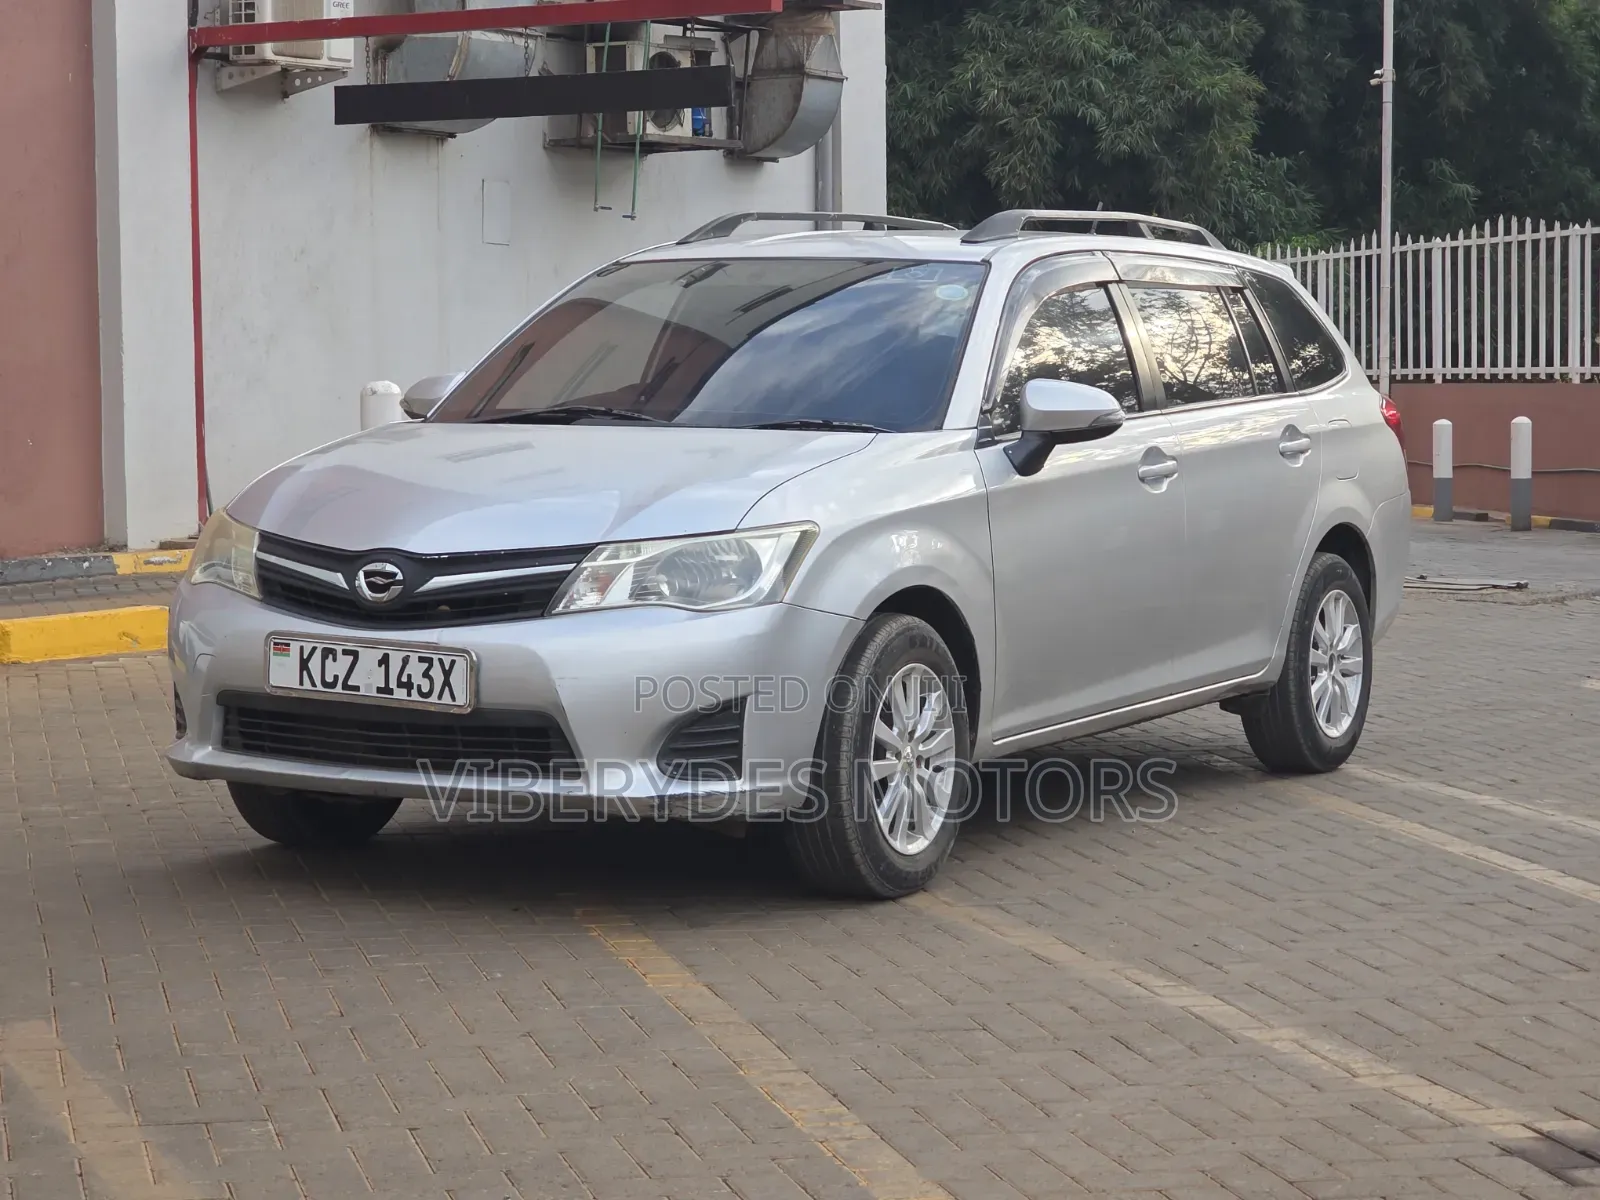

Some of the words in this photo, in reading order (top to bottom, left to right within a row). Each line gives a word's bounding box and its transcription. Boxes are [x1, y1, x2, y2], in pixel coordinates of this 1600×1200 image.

[332, 1, 350, 9] GREE
[299, 645, 361, 693] KCZ
[376, 652, 456, 702] 143X
